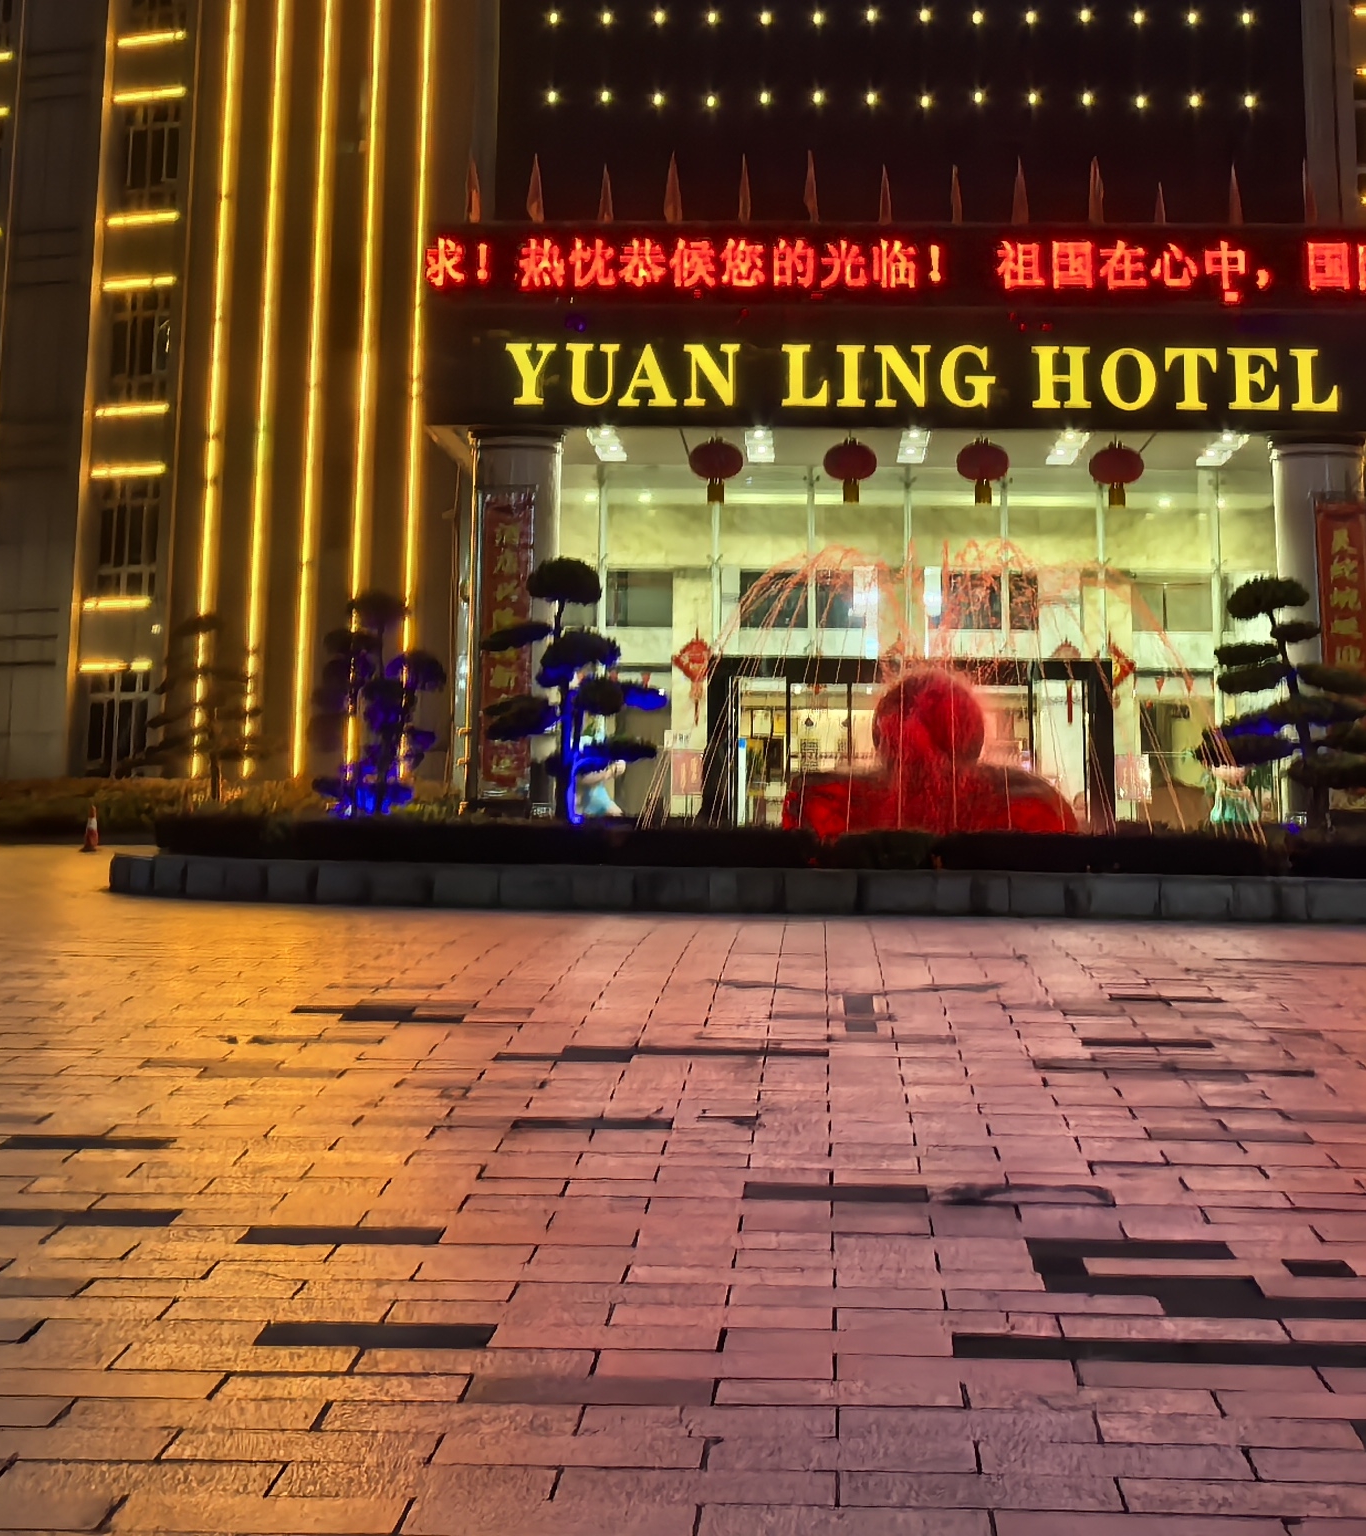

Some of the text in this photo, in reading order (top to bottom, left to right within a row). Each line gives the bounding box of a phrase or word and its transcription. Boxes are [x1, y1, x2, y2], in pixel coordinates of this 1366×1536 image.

[505, 342, 1339, 412] YUAN LING HOTEL
